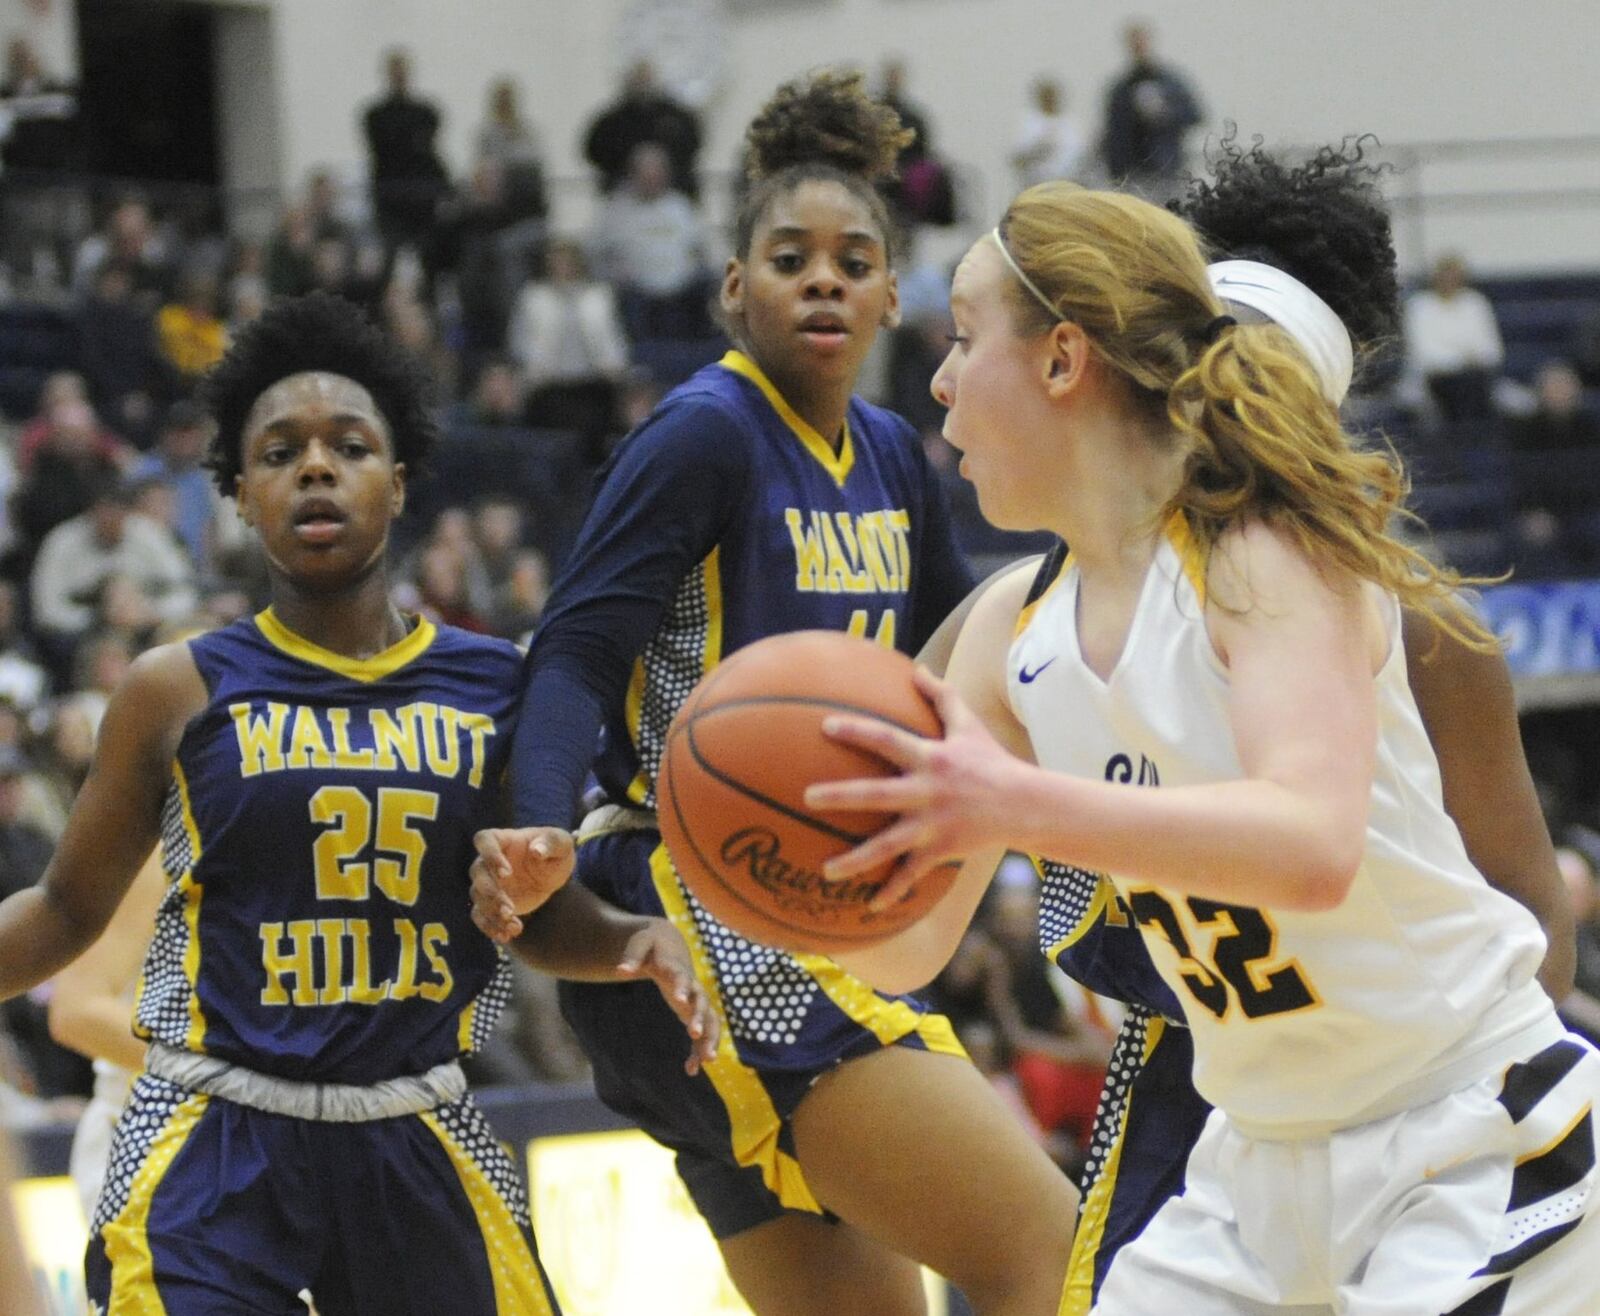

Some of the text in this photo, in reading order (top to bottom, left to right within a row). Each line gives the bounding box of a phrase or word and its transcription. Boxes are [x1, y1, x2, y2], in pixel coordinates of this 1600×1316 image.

[229, 702, 496, 788] WALNUT
[308, 786, 440, 906] 25
[259, 918, 454, 1006] HILLS
[1127, 885, 1324, 1024] 32
